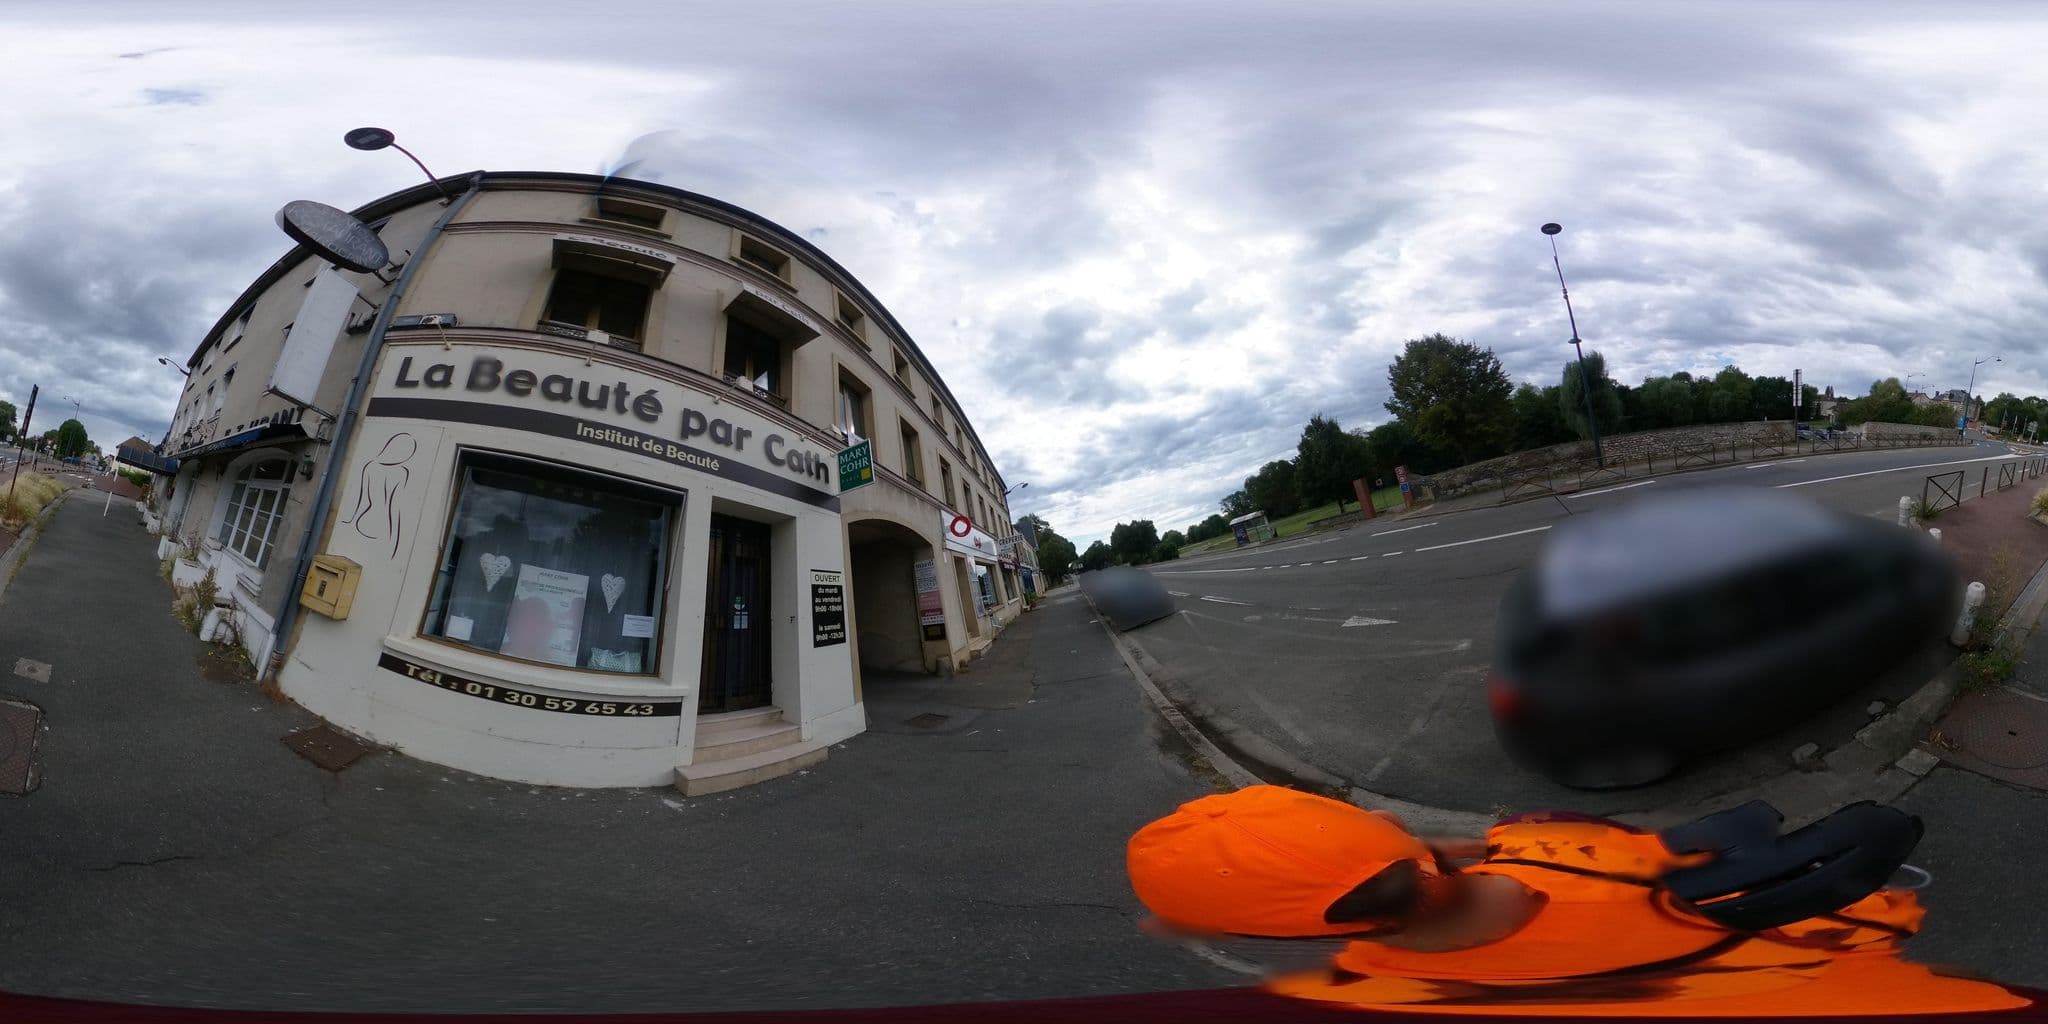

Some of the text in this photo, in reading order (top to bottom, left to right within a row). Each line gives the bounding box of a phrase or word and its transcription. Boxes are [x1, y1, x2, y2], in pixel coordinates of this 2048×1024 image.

[395, 355, 830, 484] La Beauté par Cath
[576, 422, 720, 471] Institut de Beauté
[840, 445, 868, 464] MARY
[840, 457, 869, 475] COHR
[814, 574, 841, 582] OUVERT
[406, 663, 442, 686] Tél
[465, 682, 495, 698] 01
[504, 691, 536, 706] 30
[544, 698, 577, 711] 59
[585, 703, 617, 715] 65
[624, 704, 654, 716] 43
